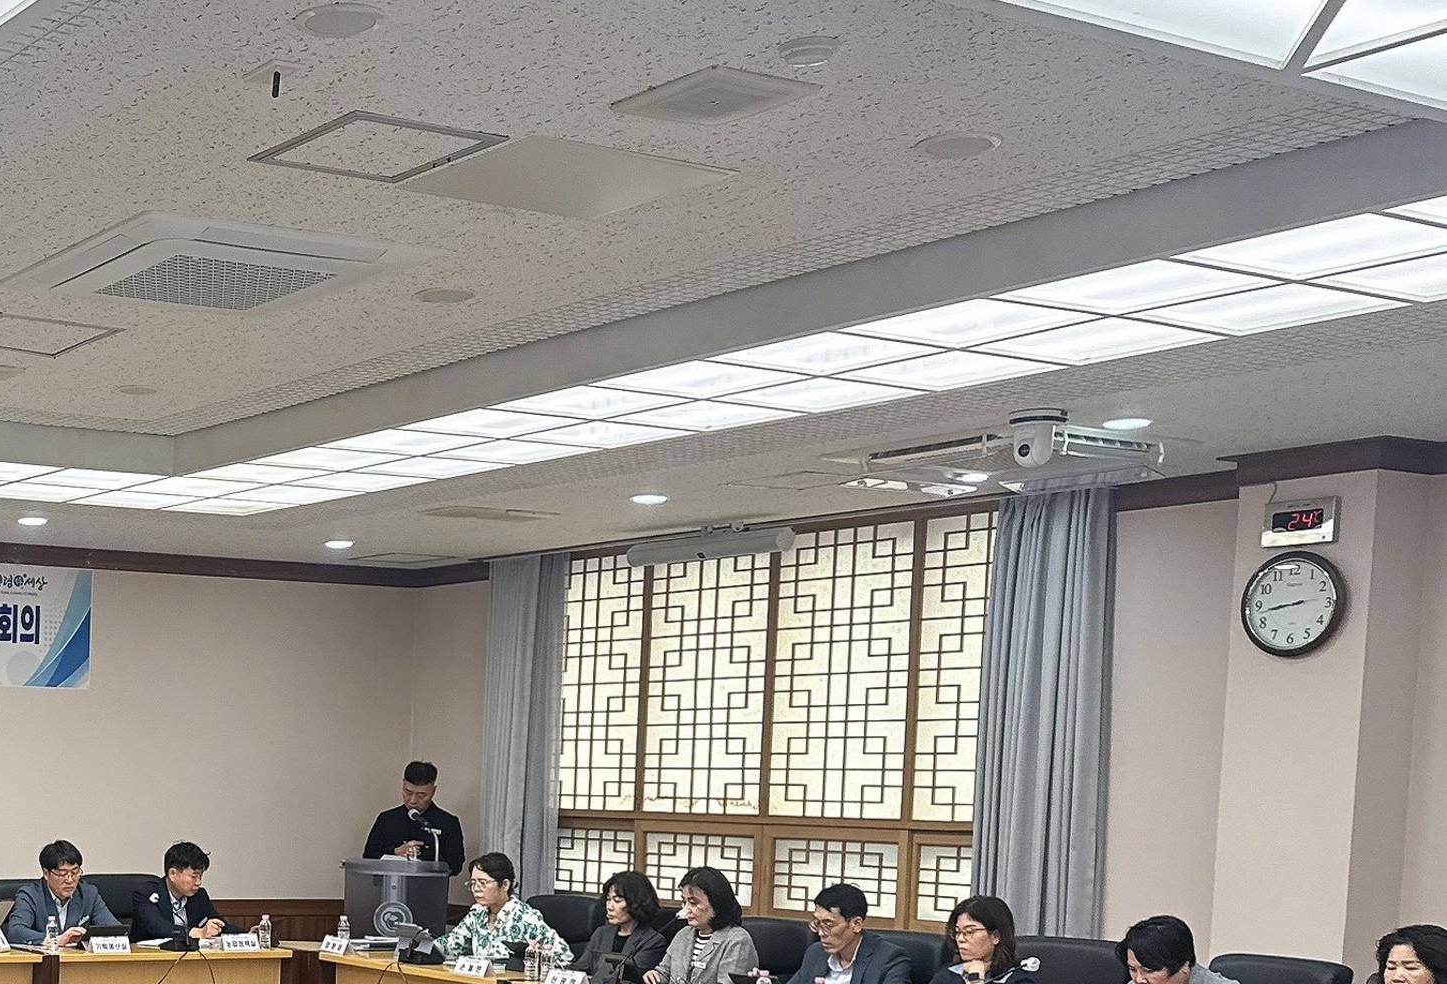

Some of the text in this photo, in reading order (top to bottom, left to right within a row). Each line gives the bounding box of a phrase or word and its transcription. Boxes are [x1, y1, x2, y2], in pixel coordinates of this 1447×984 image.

[1273, 570, 1283, 582] 11
[1310, 569, 1315, 580] 1
[1260, 583, 1272, 595] 10
[1319, 580, 1327, 592] 2
[1255, 600, 1263, 611] 9
[1325, 597, 1332, 608] 3
[1259, 617, 1267, 628] 8
[1316, 614, 1324, 625] 4
[1271, 629, 1278, 641] 7
[1286, 632, 1294, 644] 6
[1303, 627, 1311, 639] 5
